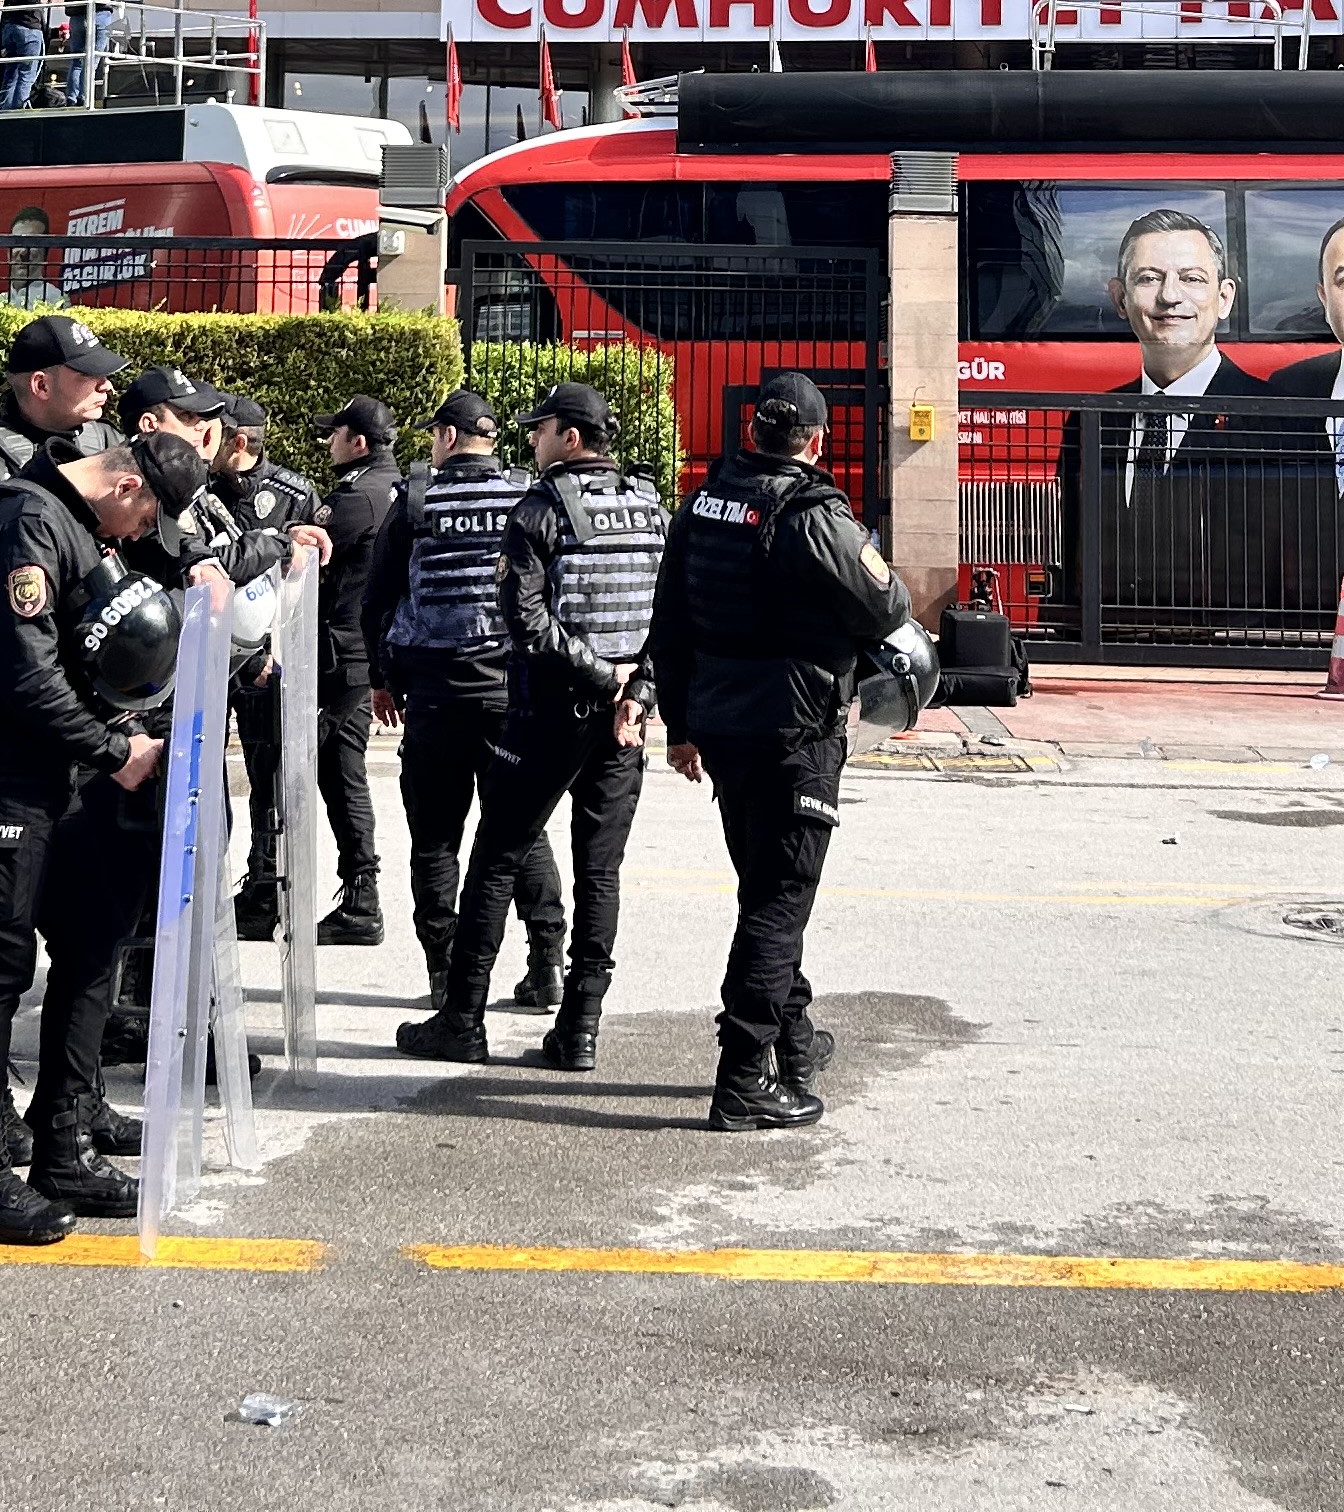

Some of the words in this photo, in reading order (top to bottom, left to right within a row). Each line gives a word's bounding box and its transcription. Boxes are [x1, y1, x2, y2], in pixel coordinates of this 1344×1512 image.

[67, 208, 125, 238] EKREM
[957, 357, 1006, 380] GÜR
[692, 490, 725, 520] ÖZEL
[439, 511, 508, 532] POLİS
[591, 508, 648, 530] OLİS
[84, 622, 108, 652] 06
